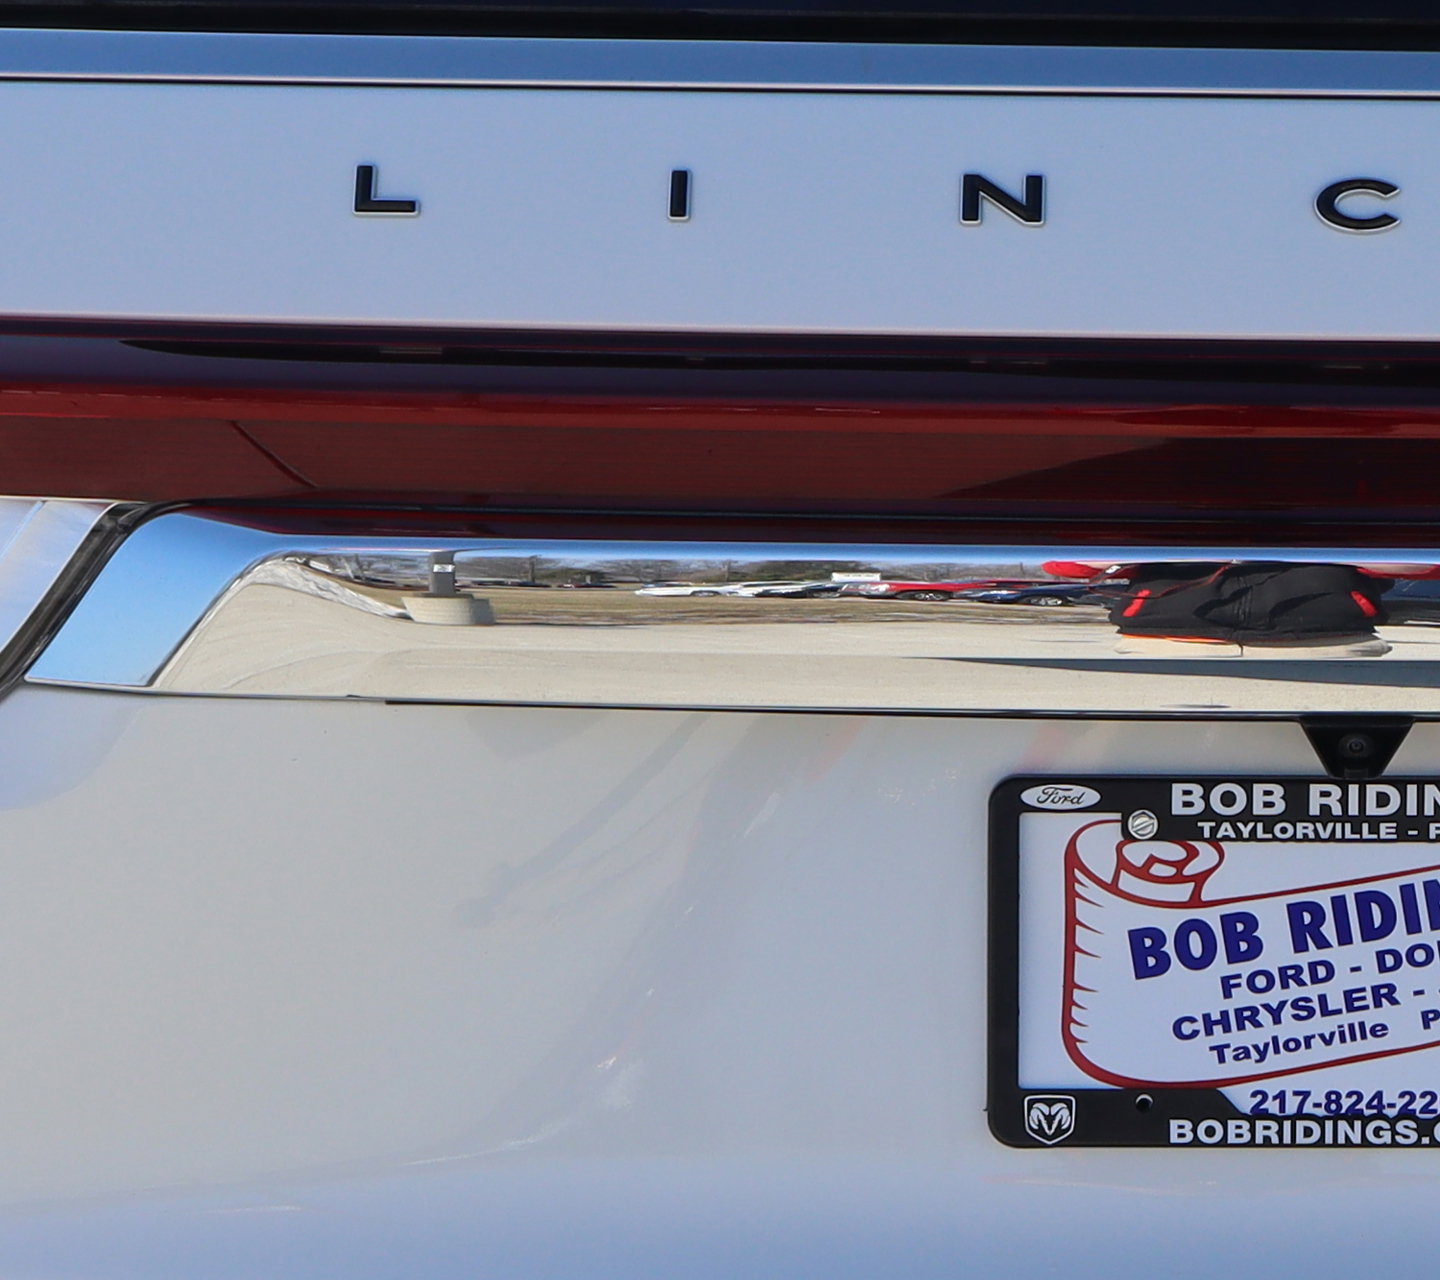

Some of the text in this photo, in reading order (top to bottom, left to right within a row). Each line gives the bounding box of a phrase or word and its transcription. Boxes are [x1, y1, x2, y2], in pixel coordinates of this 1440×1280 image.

[1170, 783, 1287, 817] BOB
[1197, 821, 1398, 840] TAYLORVILLE
[1127, 911, 1262, 980] BOB
[1220, 963, 1334, 999] FORD
[1171, 982, 1401, 1041] CHRYSLER
[1209, 1020, 1390, 1066] Taylorville
